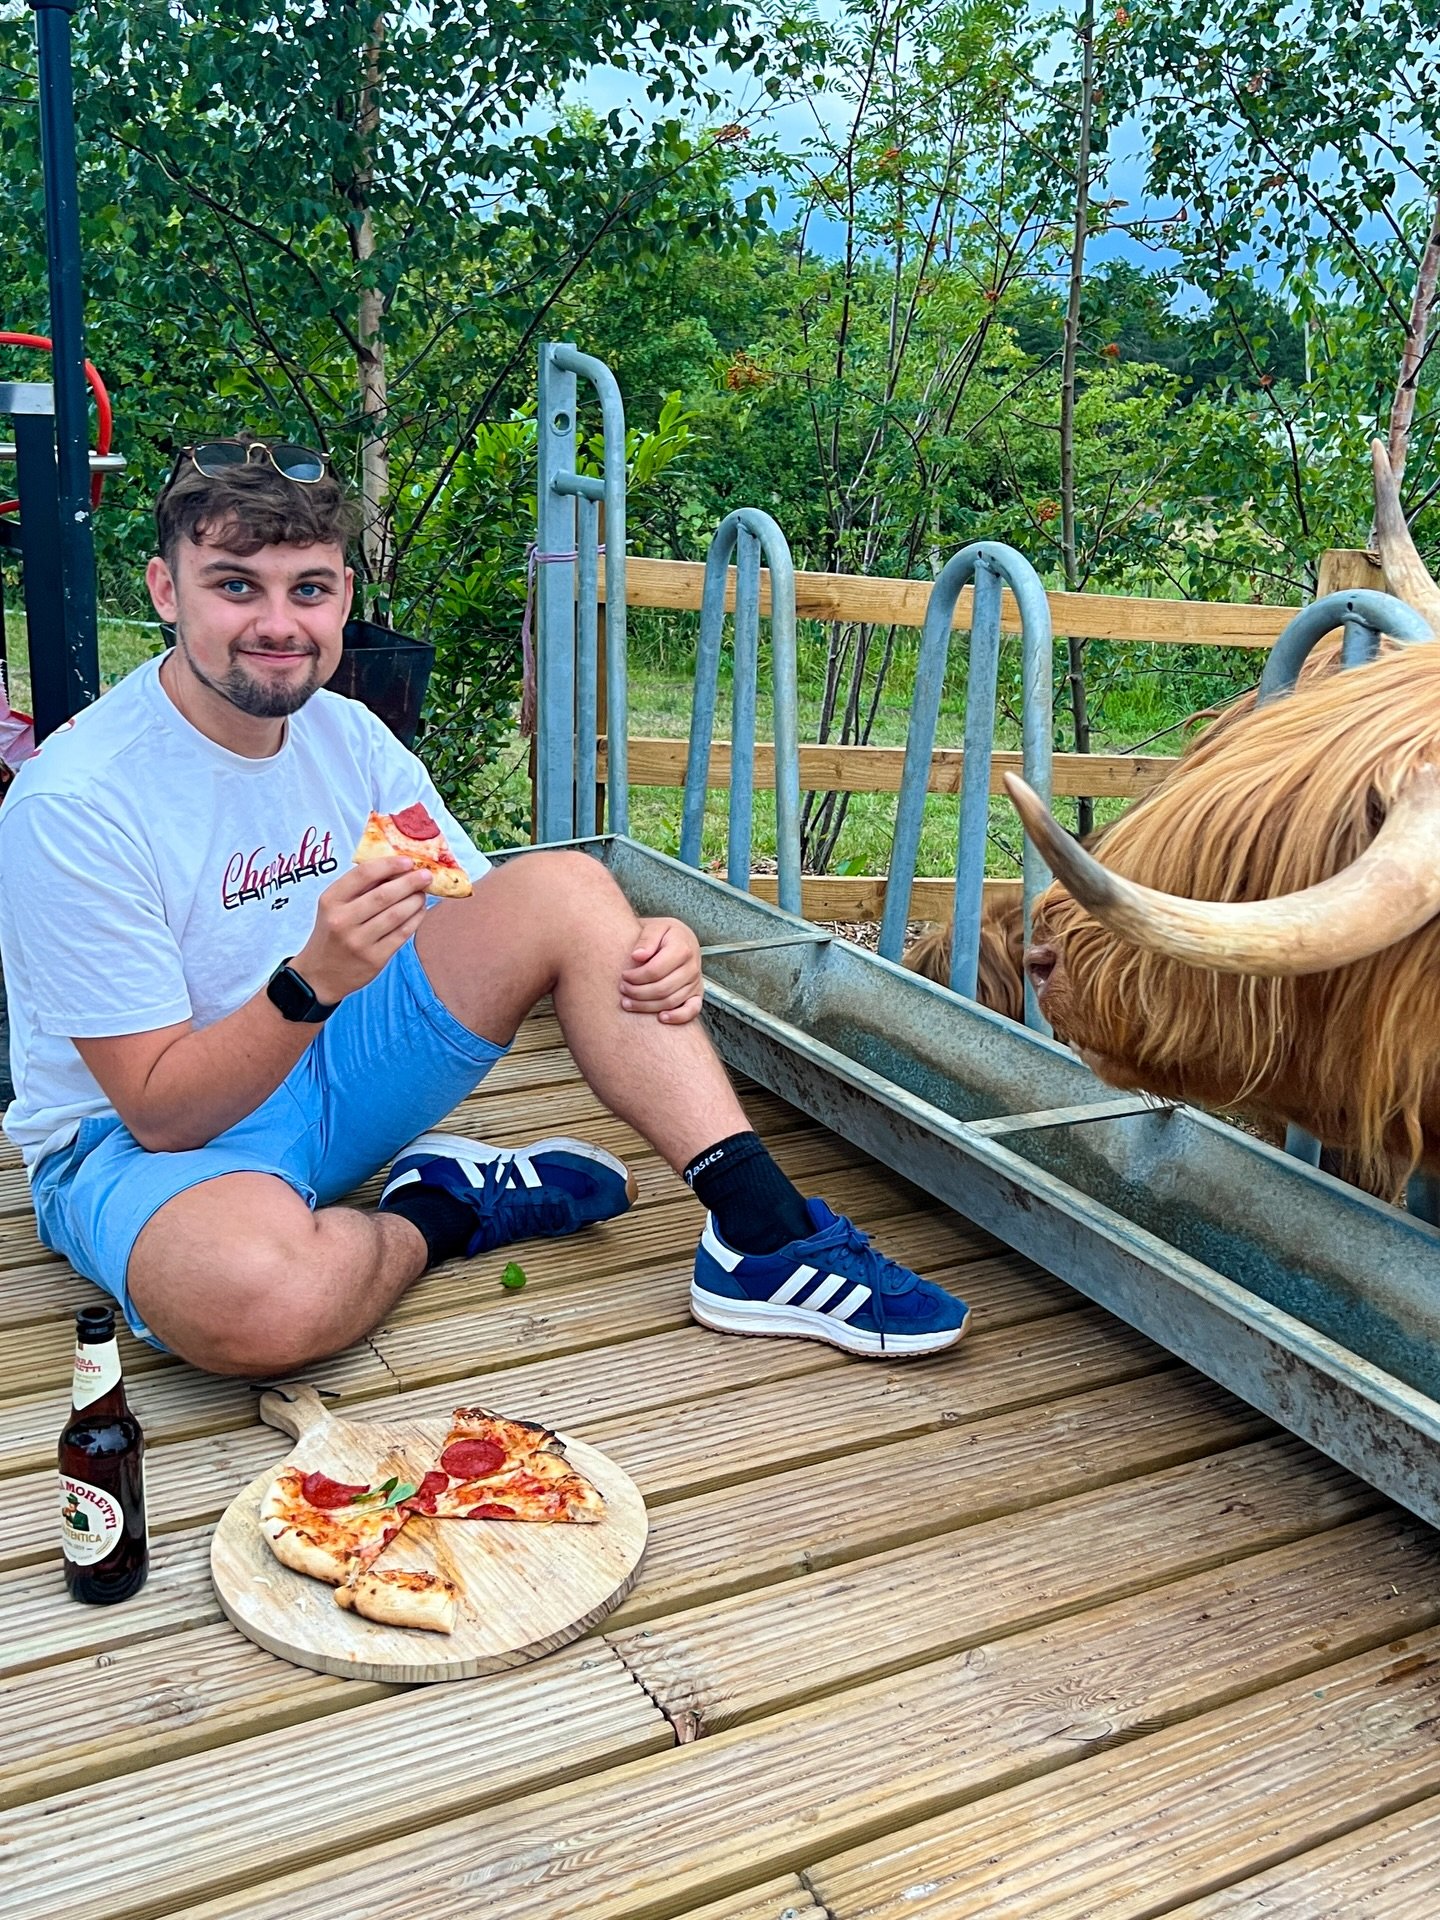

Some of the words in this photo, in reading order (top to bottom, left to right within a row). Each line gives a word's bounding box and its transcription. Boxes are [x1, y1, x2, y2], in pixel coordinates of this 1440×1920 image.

[223, 826, 333, 903] Chevrolet
[223, 857, 338, 910] CAMARO
[65, 1481, 117, 1530] MORETTI
